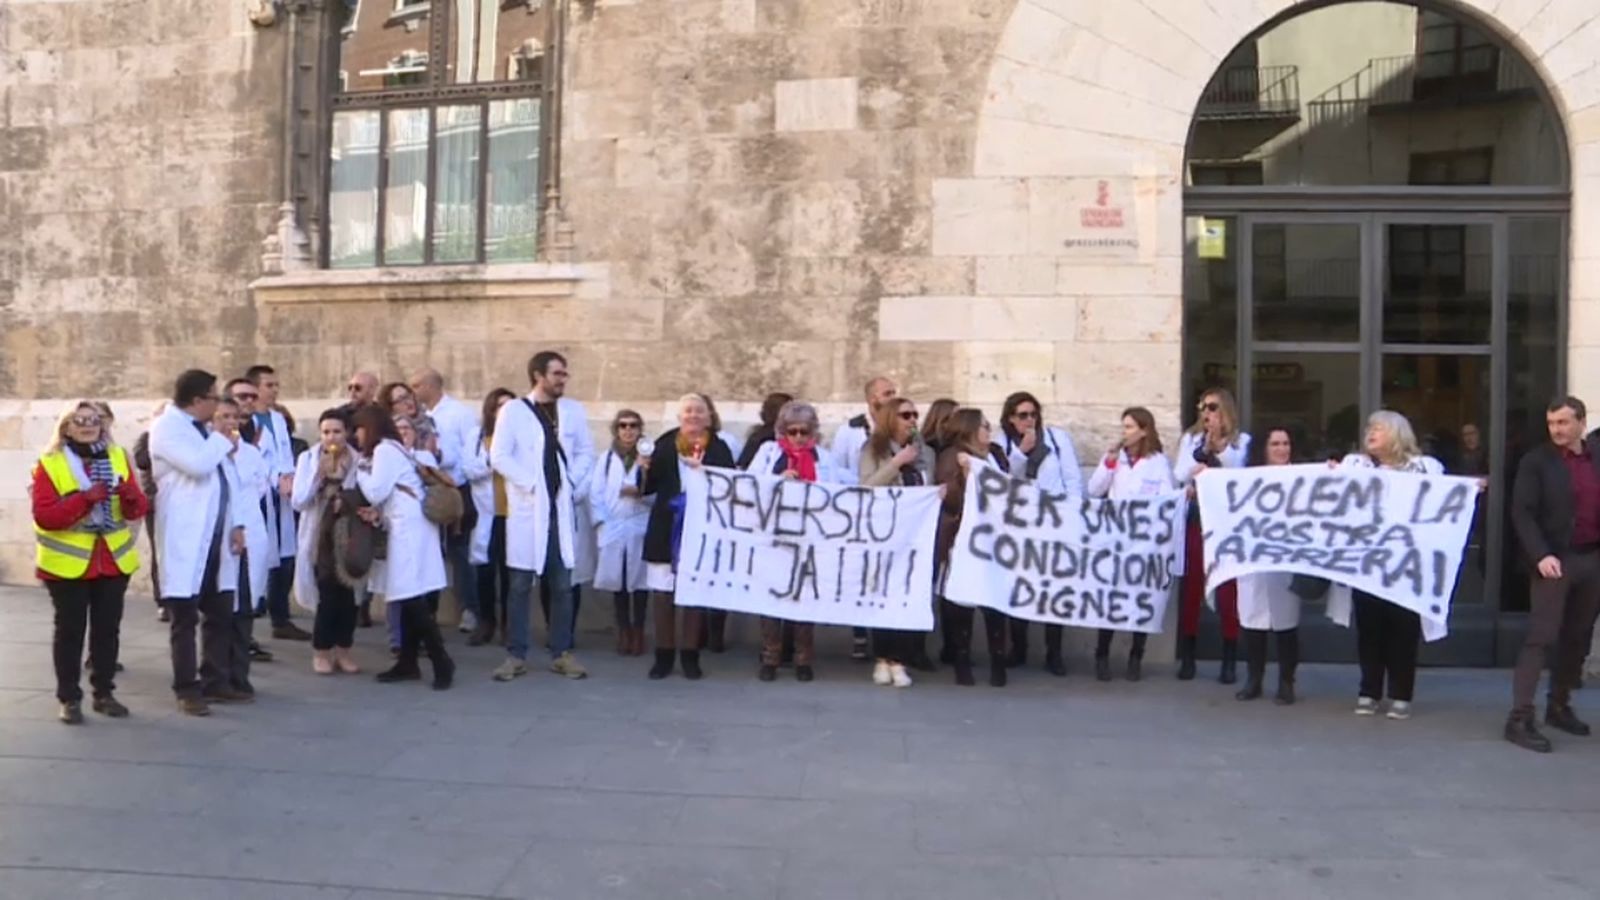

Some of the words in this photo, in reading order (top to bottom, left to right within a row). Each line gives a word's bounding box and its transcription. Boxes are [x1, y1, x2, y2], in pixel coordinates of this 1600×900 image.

[979, 466, 1067, 528] PER
[1080, 499, 1175, 545] UNES
[1226, 476, 1384, 525] VOLEM
[1410, 480, 1469, 524] LA
[1233, 516, 1414, 547] NOSTRA
[969, 523, 1176, 591] CONDICIONS
[1009, 577, 1155, 625] DIGNES
